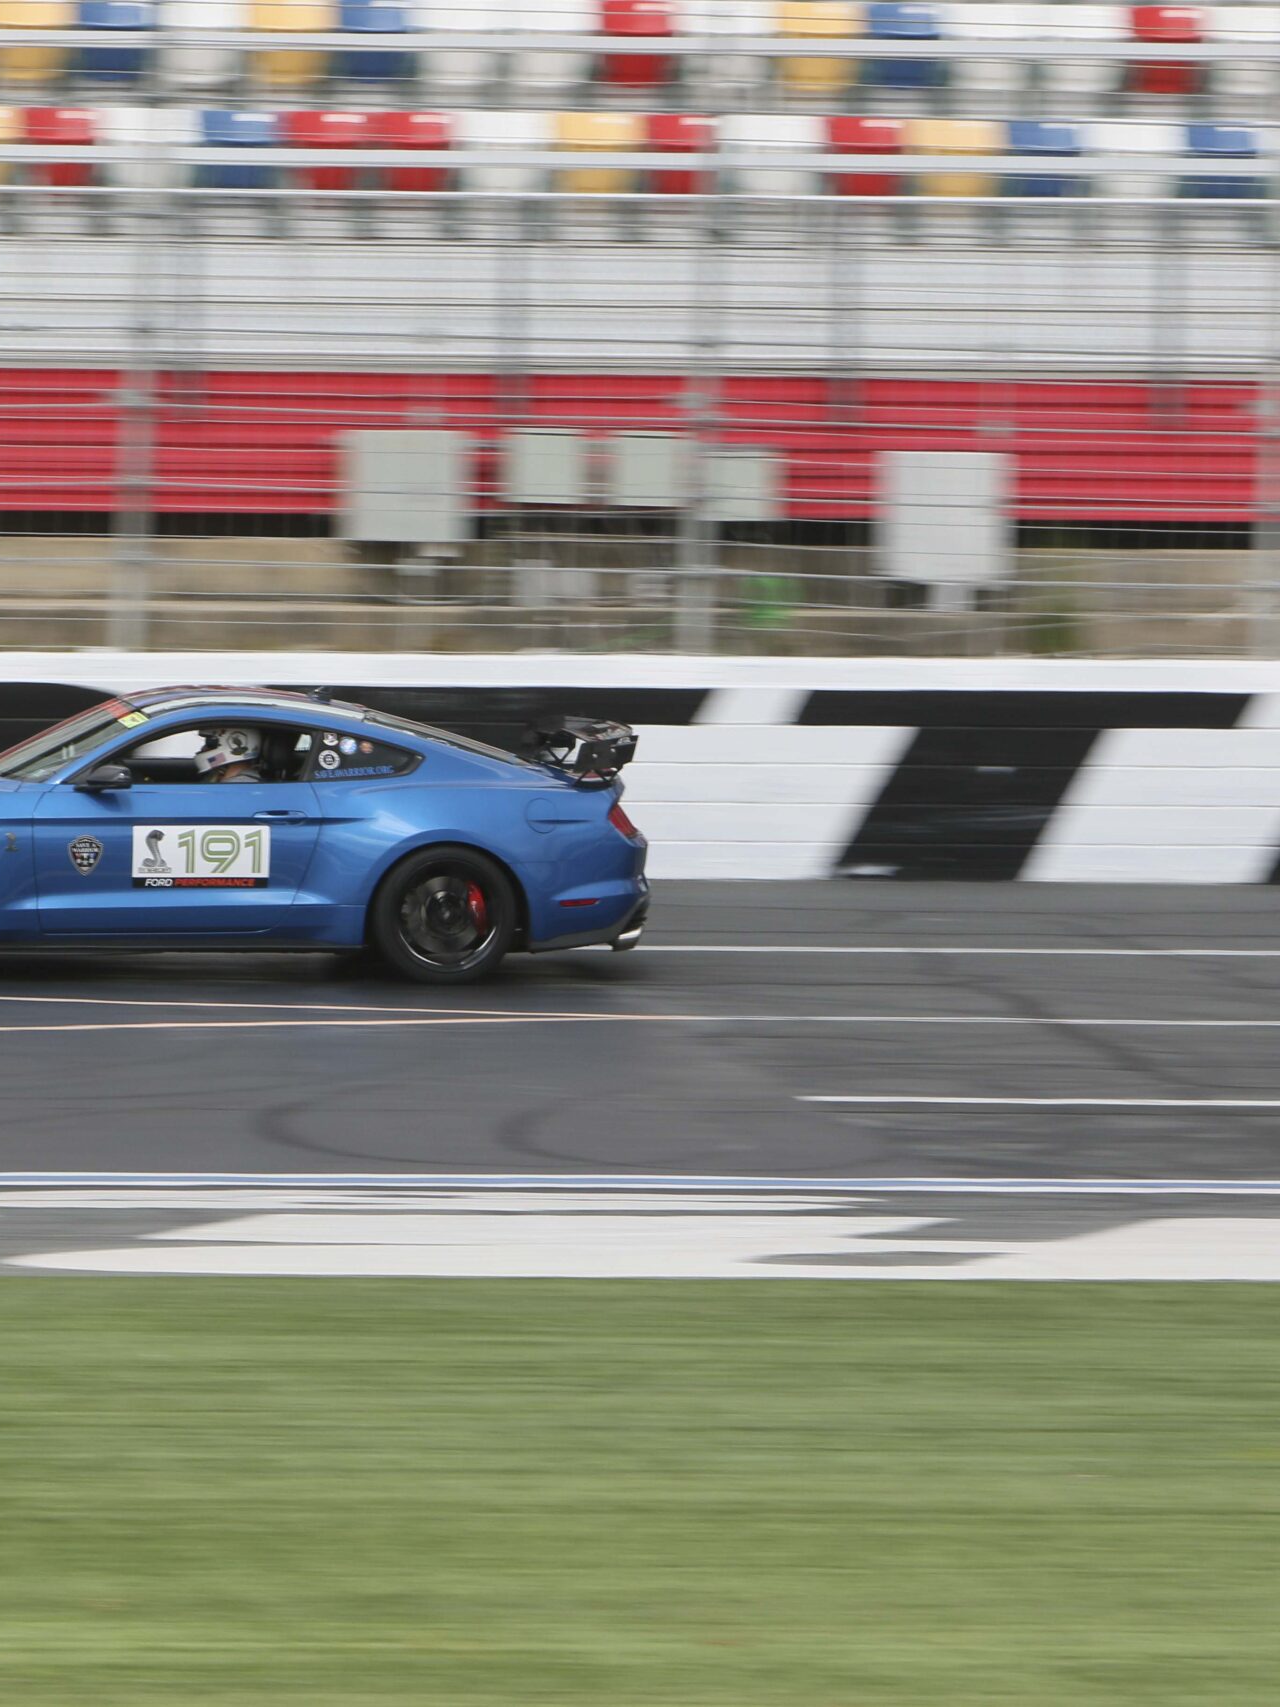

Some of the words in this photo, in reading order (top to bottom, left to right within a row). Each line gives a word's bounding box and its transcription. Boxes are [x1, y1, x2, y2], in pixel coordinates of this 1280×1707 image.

[177, 829, 262, 873] 191
[145, 879, 173, 887] FORD
[175, 879, 255, 887] PERFORMANCE
